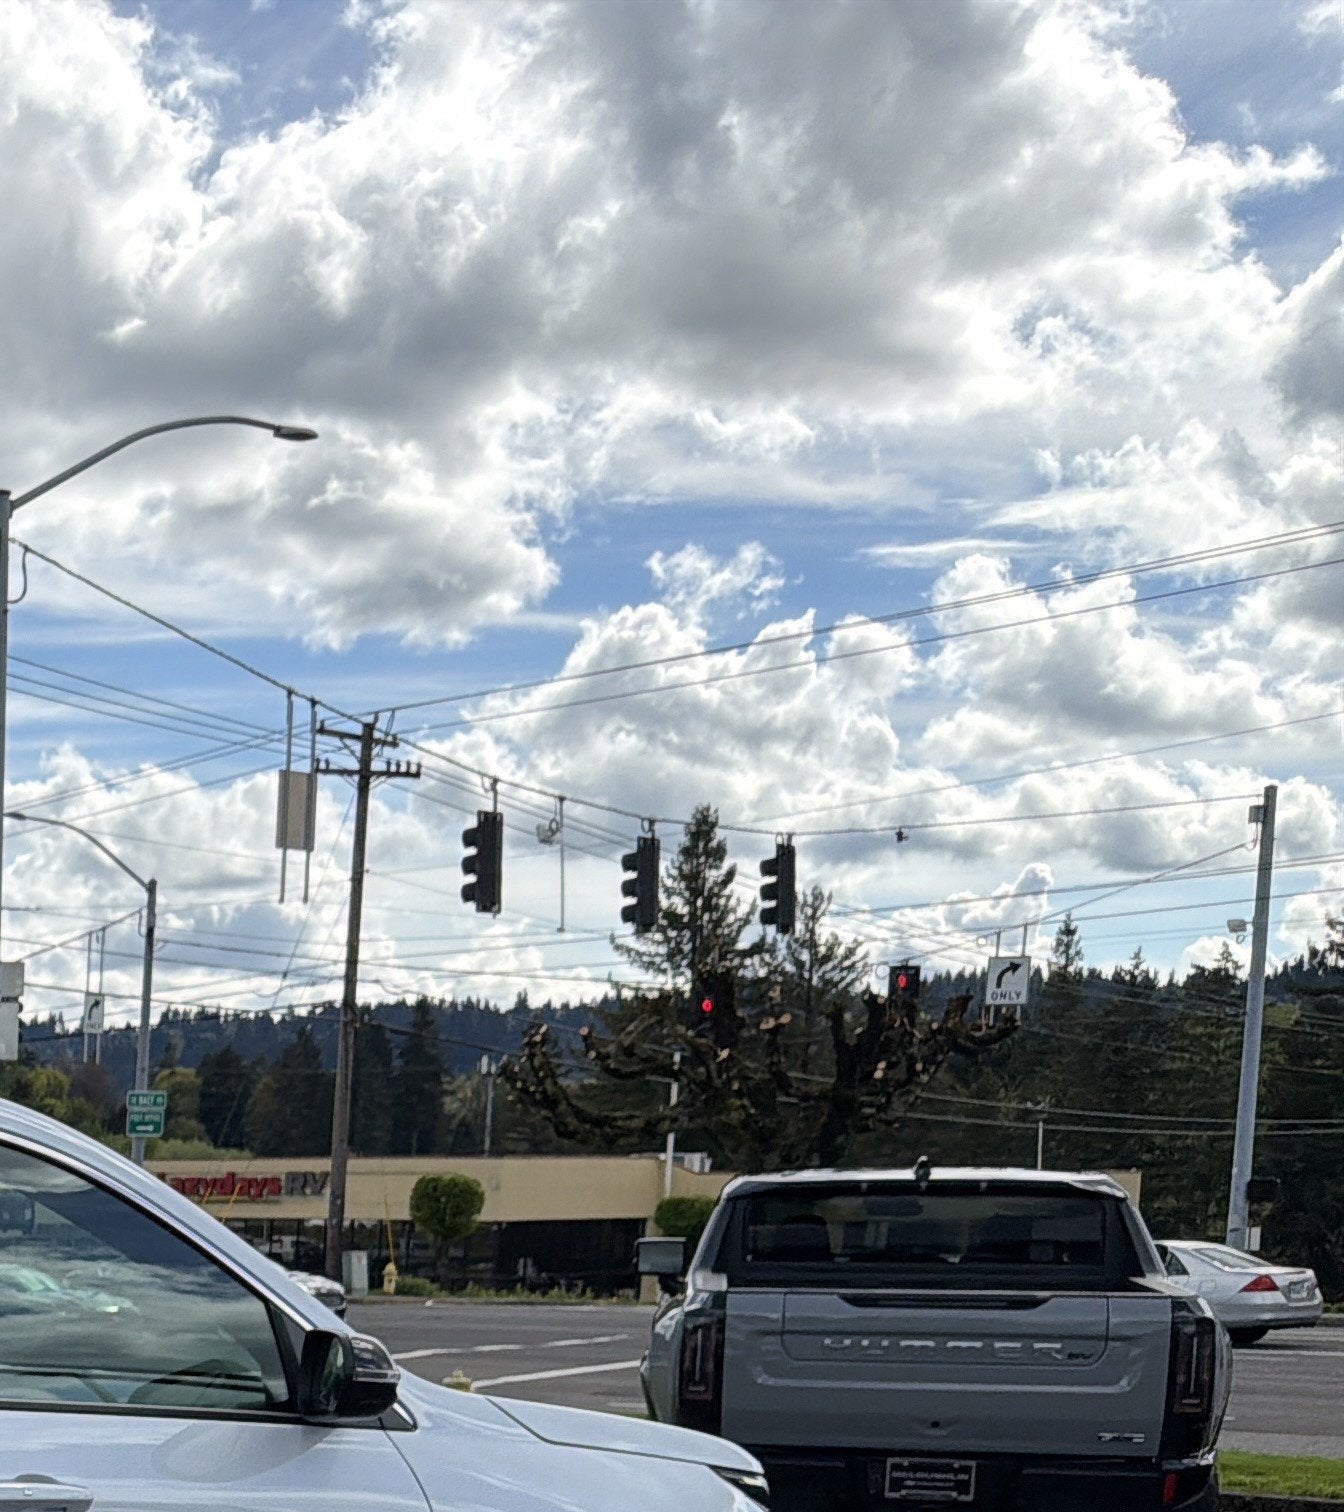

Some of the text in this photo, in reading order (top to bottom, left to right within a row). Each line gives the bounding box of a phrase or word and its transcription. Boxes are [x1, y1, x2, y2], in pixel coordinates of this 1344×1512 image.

[990, 990, 1022, 1001] ONLY
[157, 1171, 329, 1199] azydays RV
